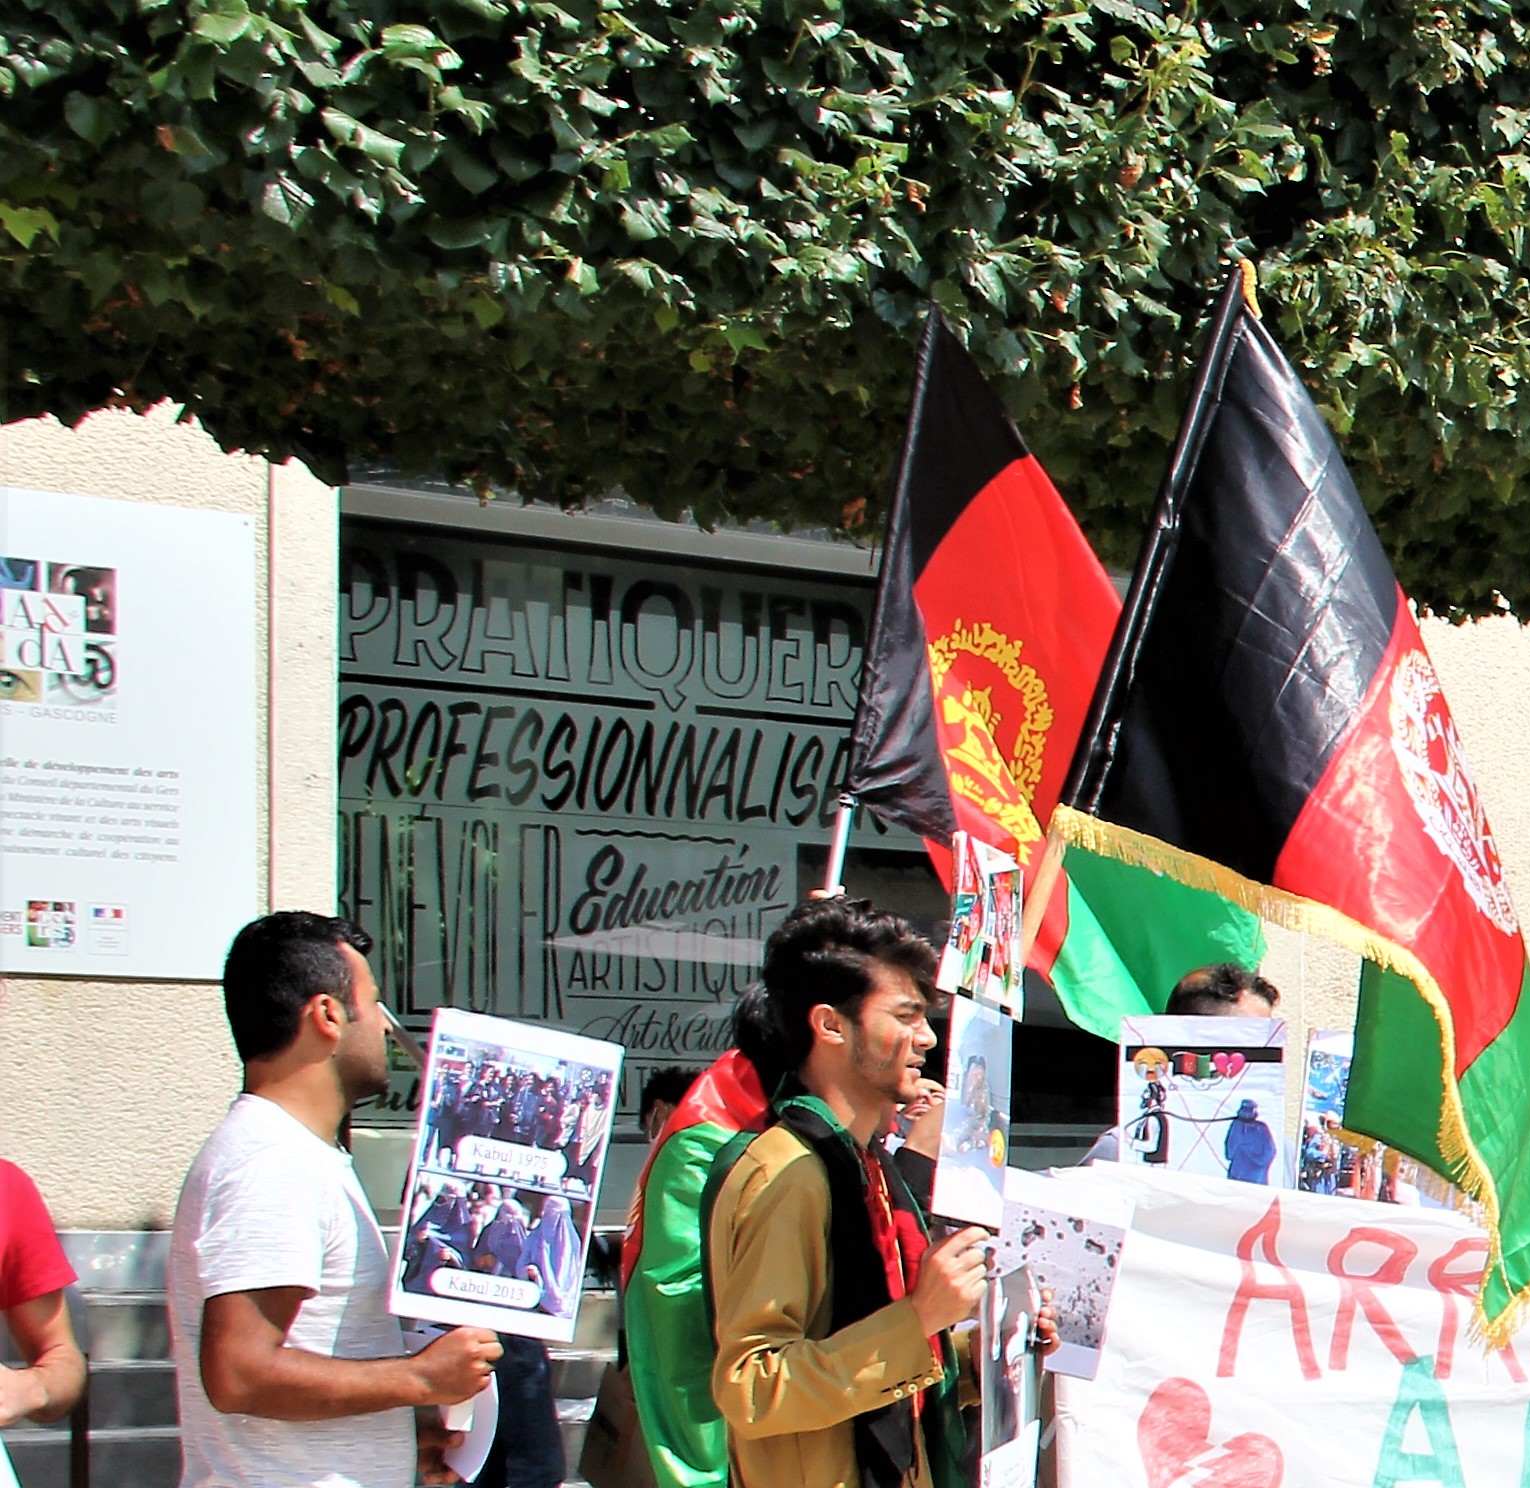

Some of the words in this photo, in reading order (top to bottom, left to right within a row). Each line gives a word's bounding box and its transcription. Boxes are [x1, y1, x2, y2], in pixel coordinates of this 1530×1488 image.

[339, 548, 864, 712] PRATIQUER
[31, 705, 118, 726] GASCOGNE
[568, 843, 783, 935] Education
[473, 1143, 513, 1163] Kabul
[518, 1152, 548, 1169] 1975
[448, 1276, 489, 1295] Kabul
[492, 1284, 524, 1301] 2013
